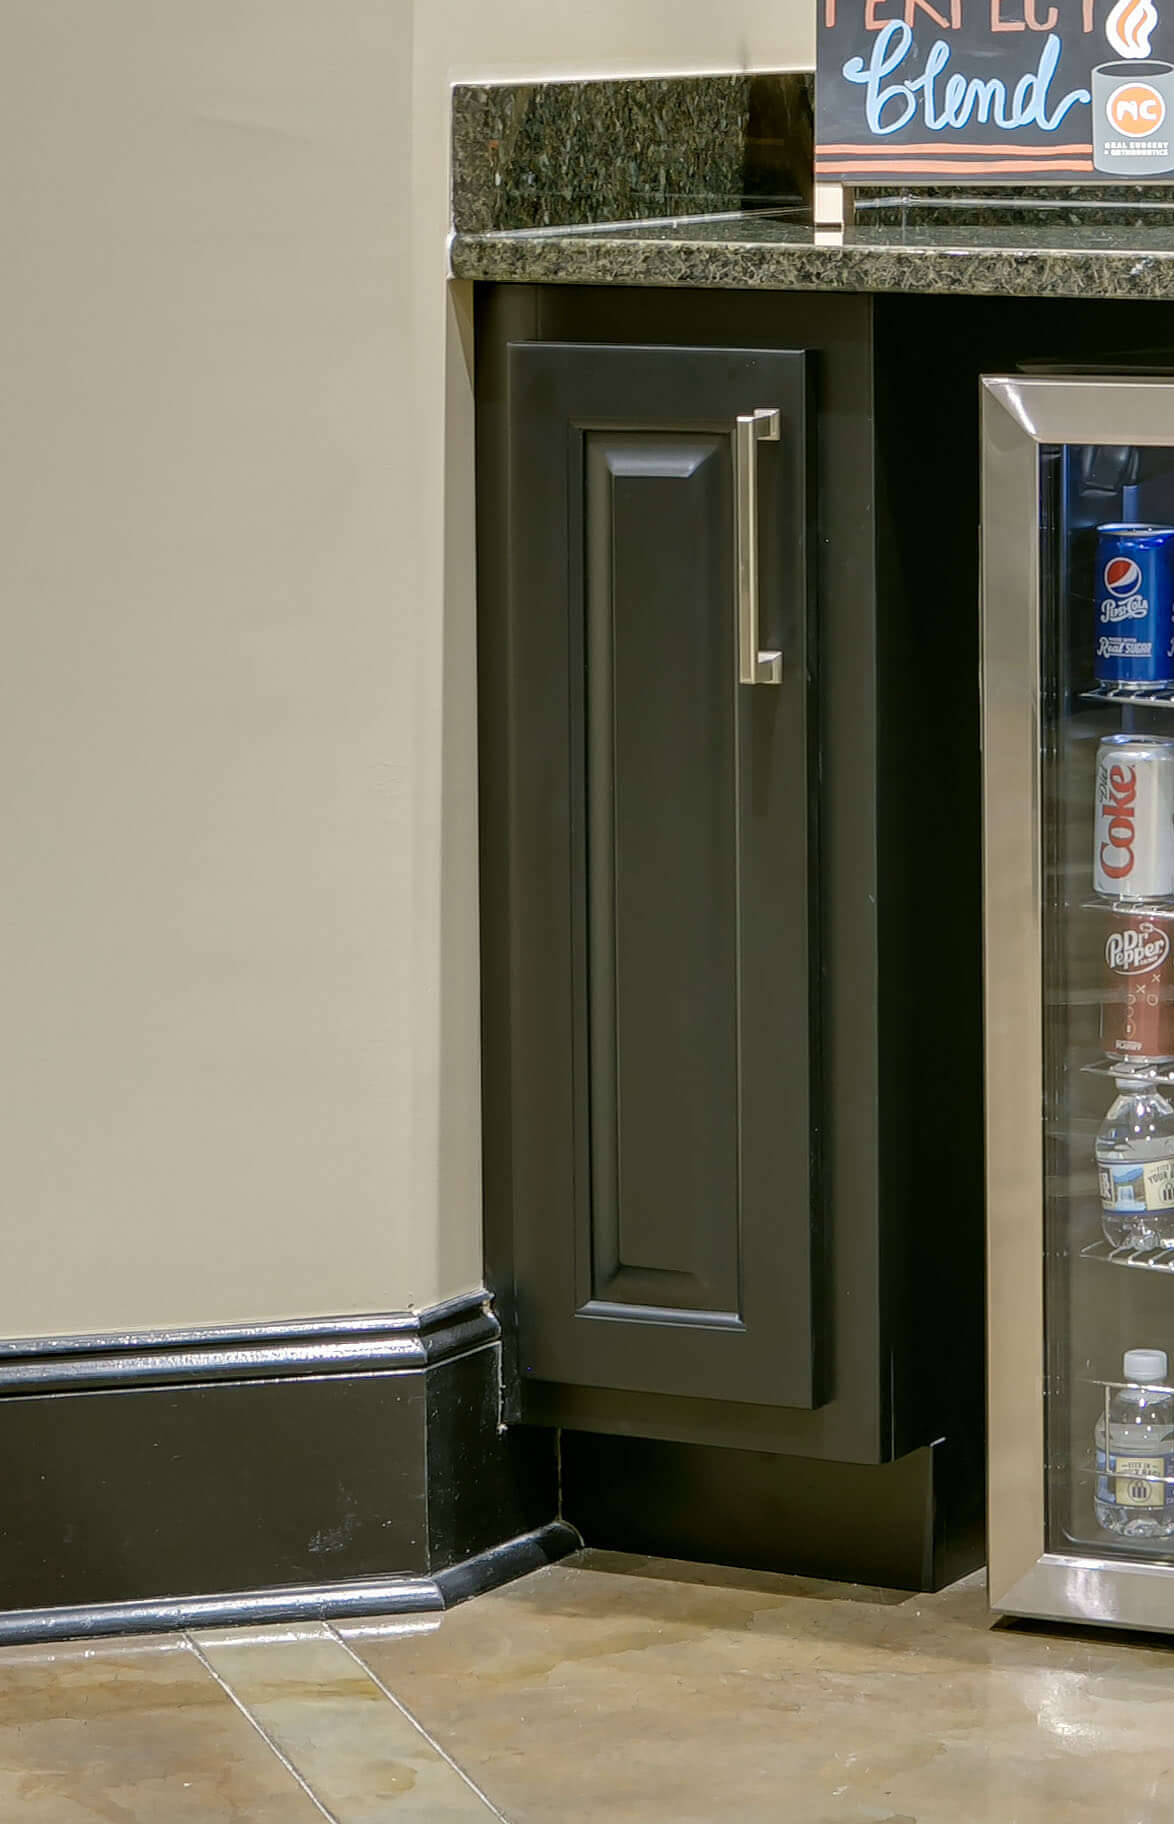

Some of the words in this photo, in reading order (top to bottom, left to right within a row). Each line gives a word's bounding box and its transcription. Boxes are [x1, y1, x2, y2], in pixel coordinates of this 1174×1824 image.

[842, 19, 1093, 137] blend
[1116, 99, 1158, 121] NC
[1100, 764, 1137, 879] Coke
[1107, 933, 1165, 970] Pepper
[1122, 929, 1150, 949] Dr
